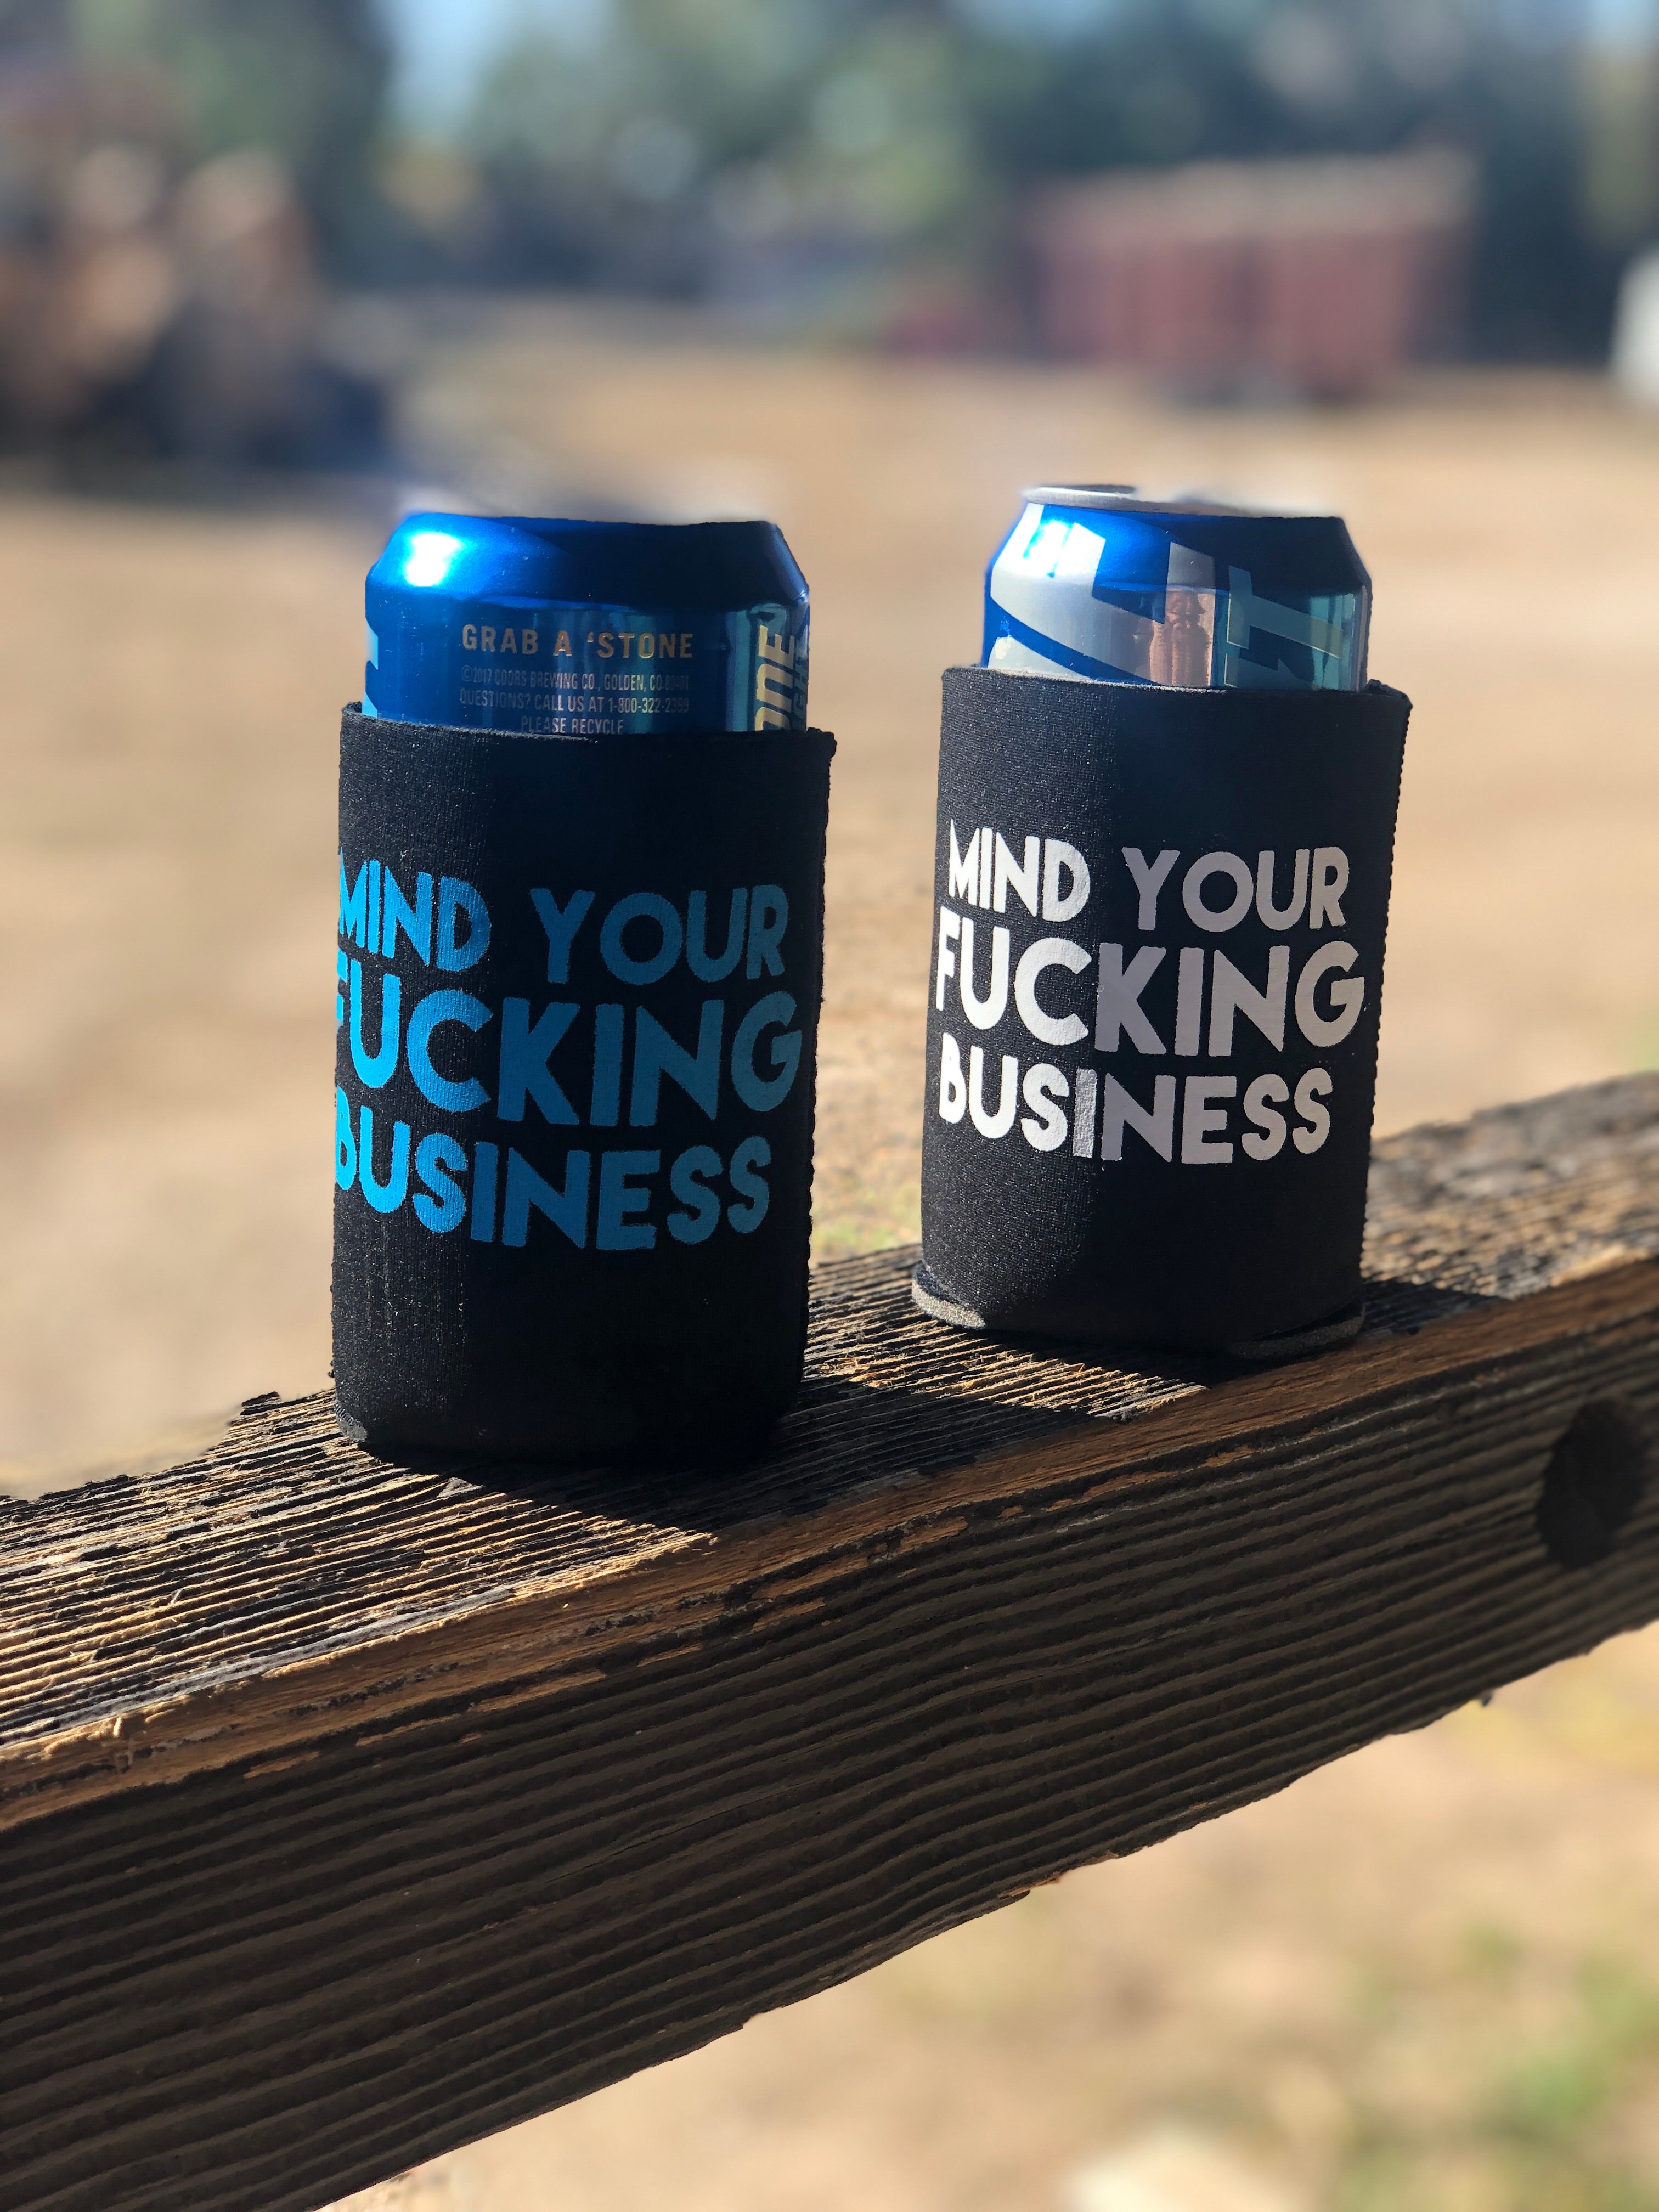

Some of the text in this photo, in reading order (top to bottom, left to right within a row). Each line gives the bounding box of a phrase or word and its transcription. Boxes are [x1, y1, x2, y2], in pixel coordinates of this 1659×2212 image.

[462, 624, 538, 655] GRAB
[553, 630, 572, 657] A
[495, 669, 527, 686] COORS
[530, 671, 578, 689] BREWING
[605, 674, 646, 692] GOLDEN,
[460, 687, 531, 709] QUESTIONS?
[534, 694, 565, 711] CALL
[568, 695, 584, 712] US
[588, 696, 605, 713] AT
[521, 715, 624, 735] PLEASE RECYCLE
[338, 847, 789, 986] MIND YOUR
[949, 819, 1350, 933] MIND YOUR
[936, 906, 1365, 1057] FUCKING
[939, 1032, 1334, 1165] BUSINESS
[335, 1085, 772, 1251] BUSINESS
